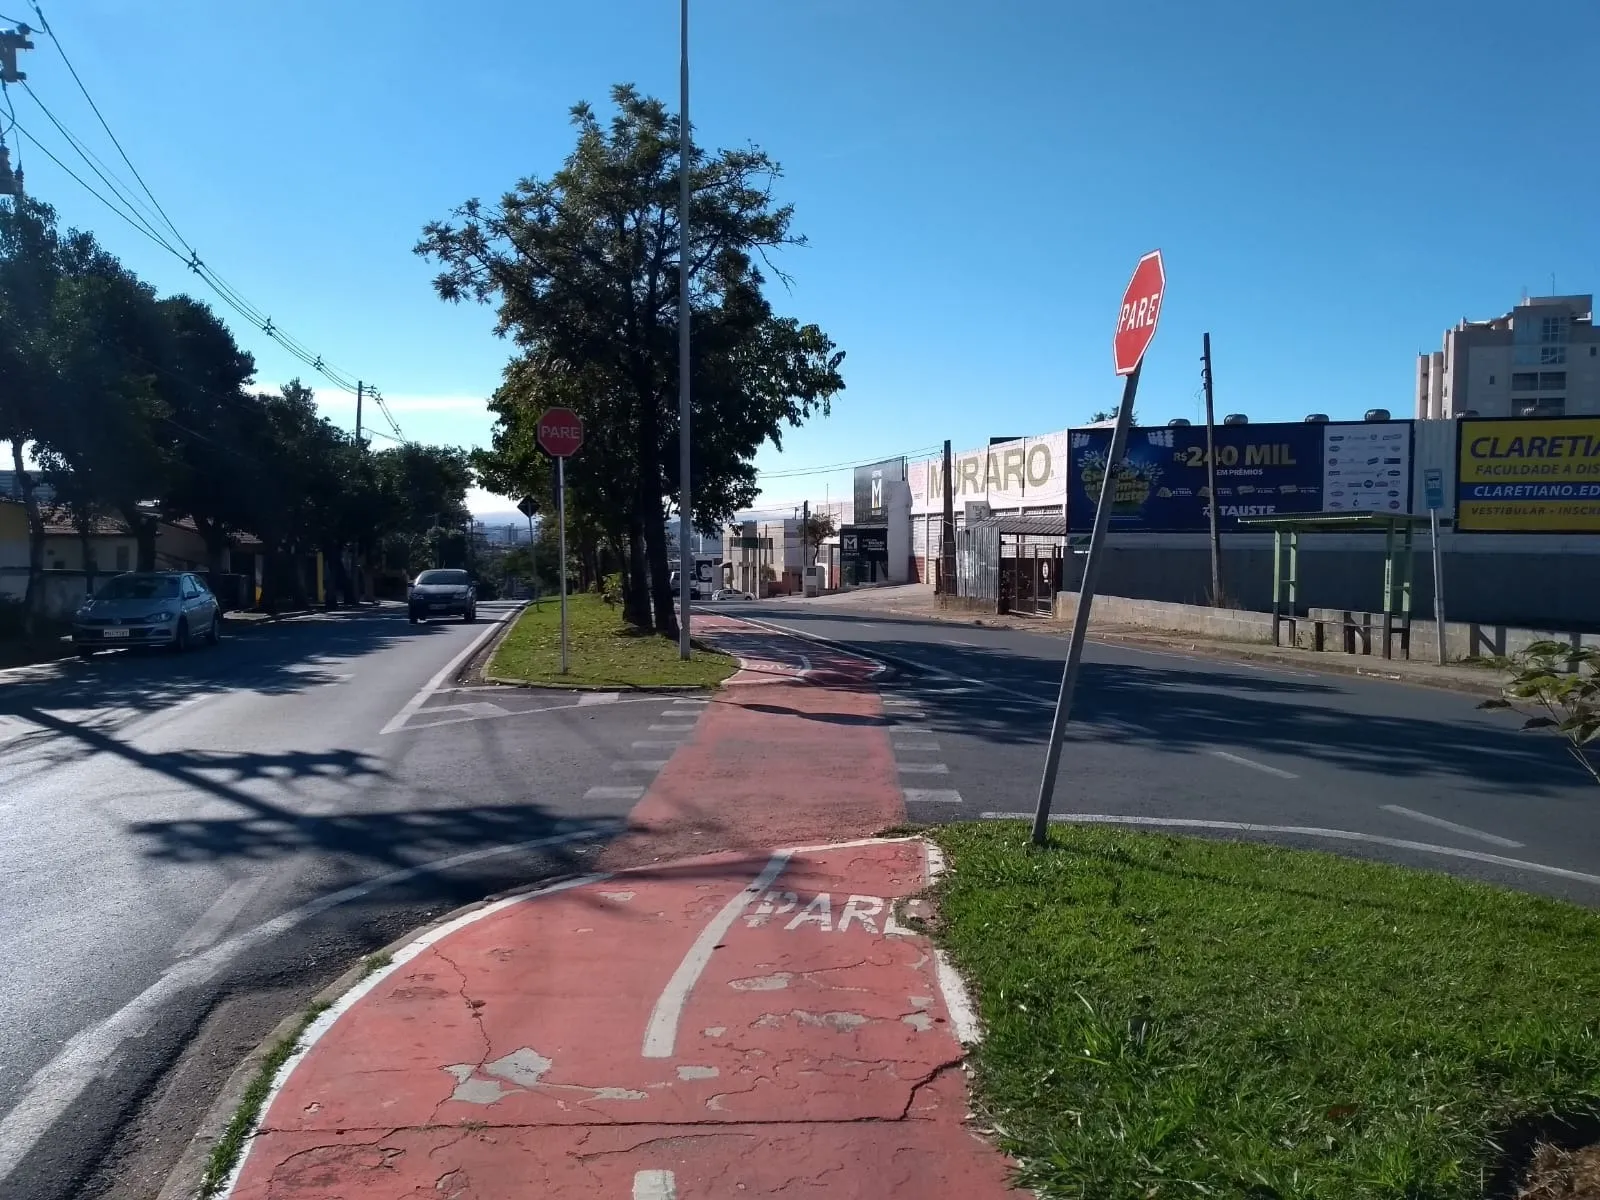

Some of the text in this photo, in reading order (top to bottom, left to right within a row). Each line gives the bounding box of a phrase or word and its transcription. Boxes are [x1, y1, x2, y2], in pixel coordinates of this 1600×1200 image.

[1118, 293, 1160, 334] PARE
[540, 425, 580, 440] PARE
[1245, 444, 1297, 466] MIL
[1216, 469, 1228, 477] EM
[1475, 464, 1559, 476] FACULDADE
[1218, 505, 1276, 517] TAUSTE
[1471, 506, 1545, 516] VESTIBULAR
